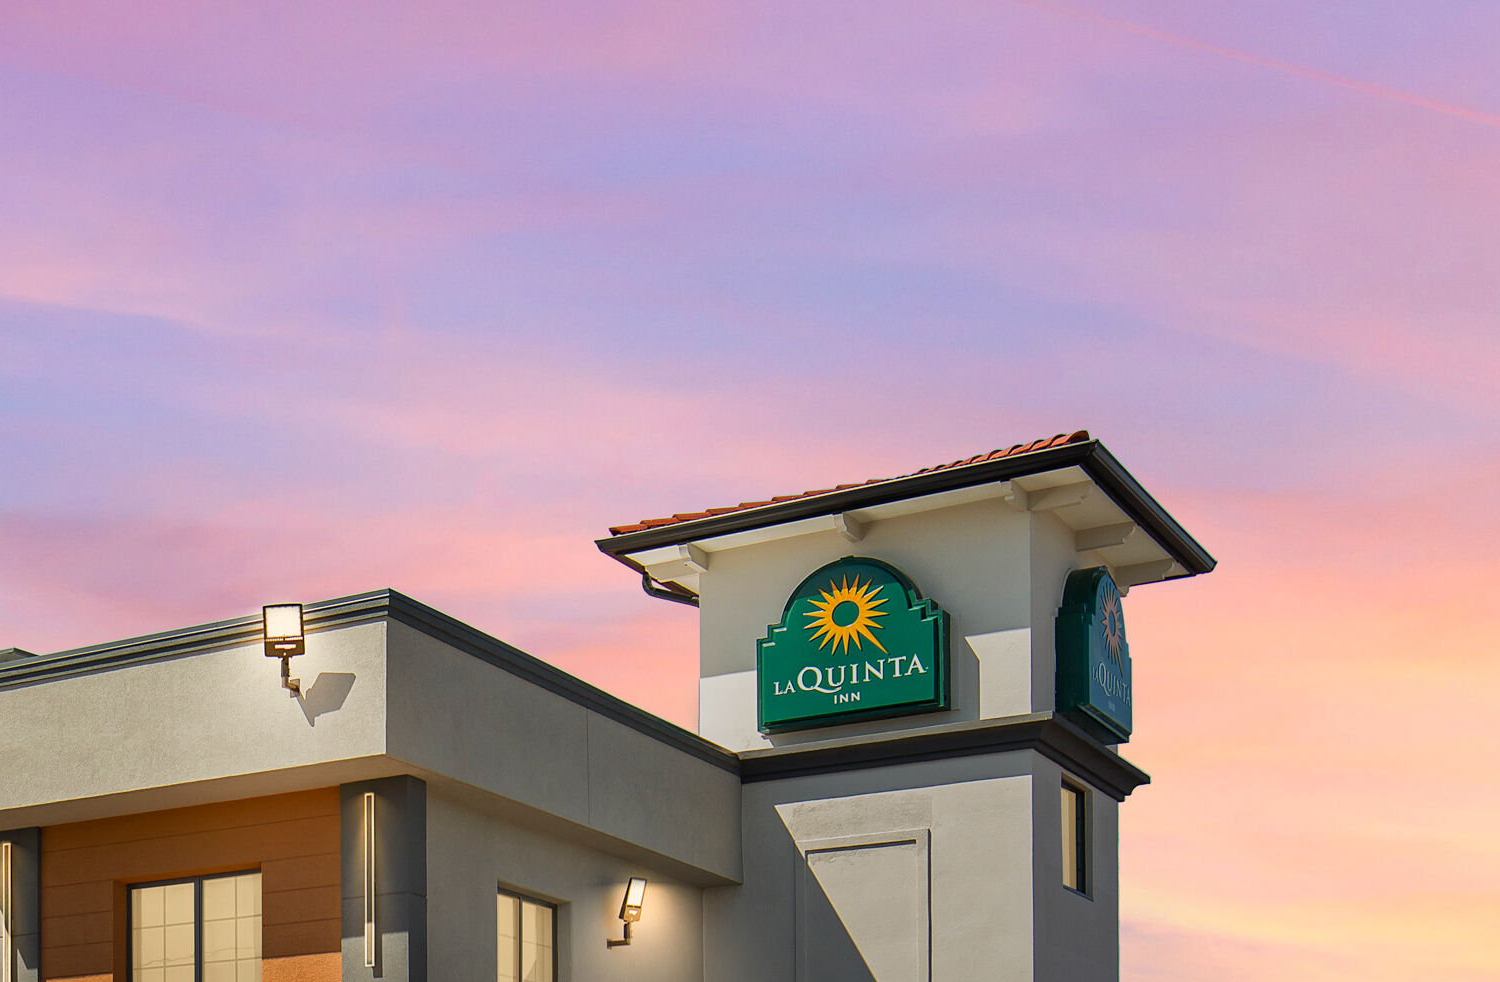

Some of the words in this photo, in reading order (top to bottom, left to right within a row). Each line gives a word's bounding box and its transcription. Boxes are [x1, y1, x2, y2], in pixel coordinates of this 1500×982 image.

[773, 680, 796, 696] LA
[797, 653, 928, 694] QUINTA
[1099, 662, 1131, 707] QUINTA
[833, 691, 861, 705] INN
